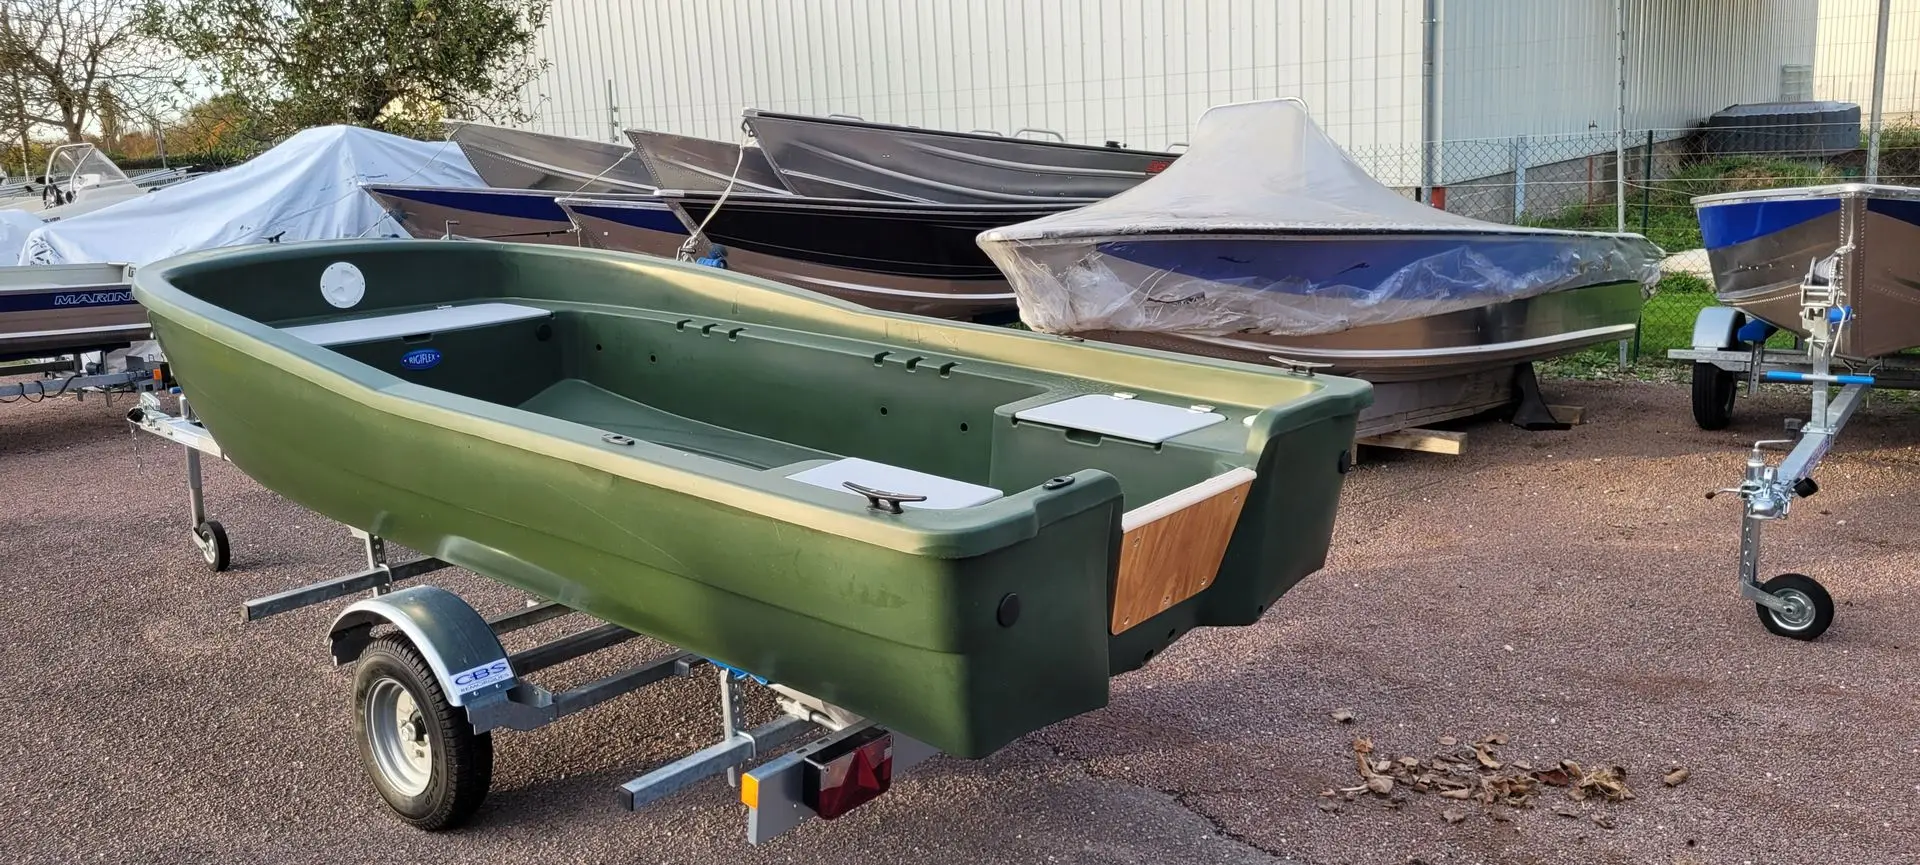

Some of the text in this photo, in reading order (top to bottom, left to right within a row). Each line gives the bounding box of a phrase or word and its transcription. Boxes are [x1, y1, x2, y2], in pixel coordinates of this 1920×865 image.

[54, 292, 135, 306] MARIN
[408, 353, 436, 365] RIGIFLEX
[455, 662, 506, 685] CBS
